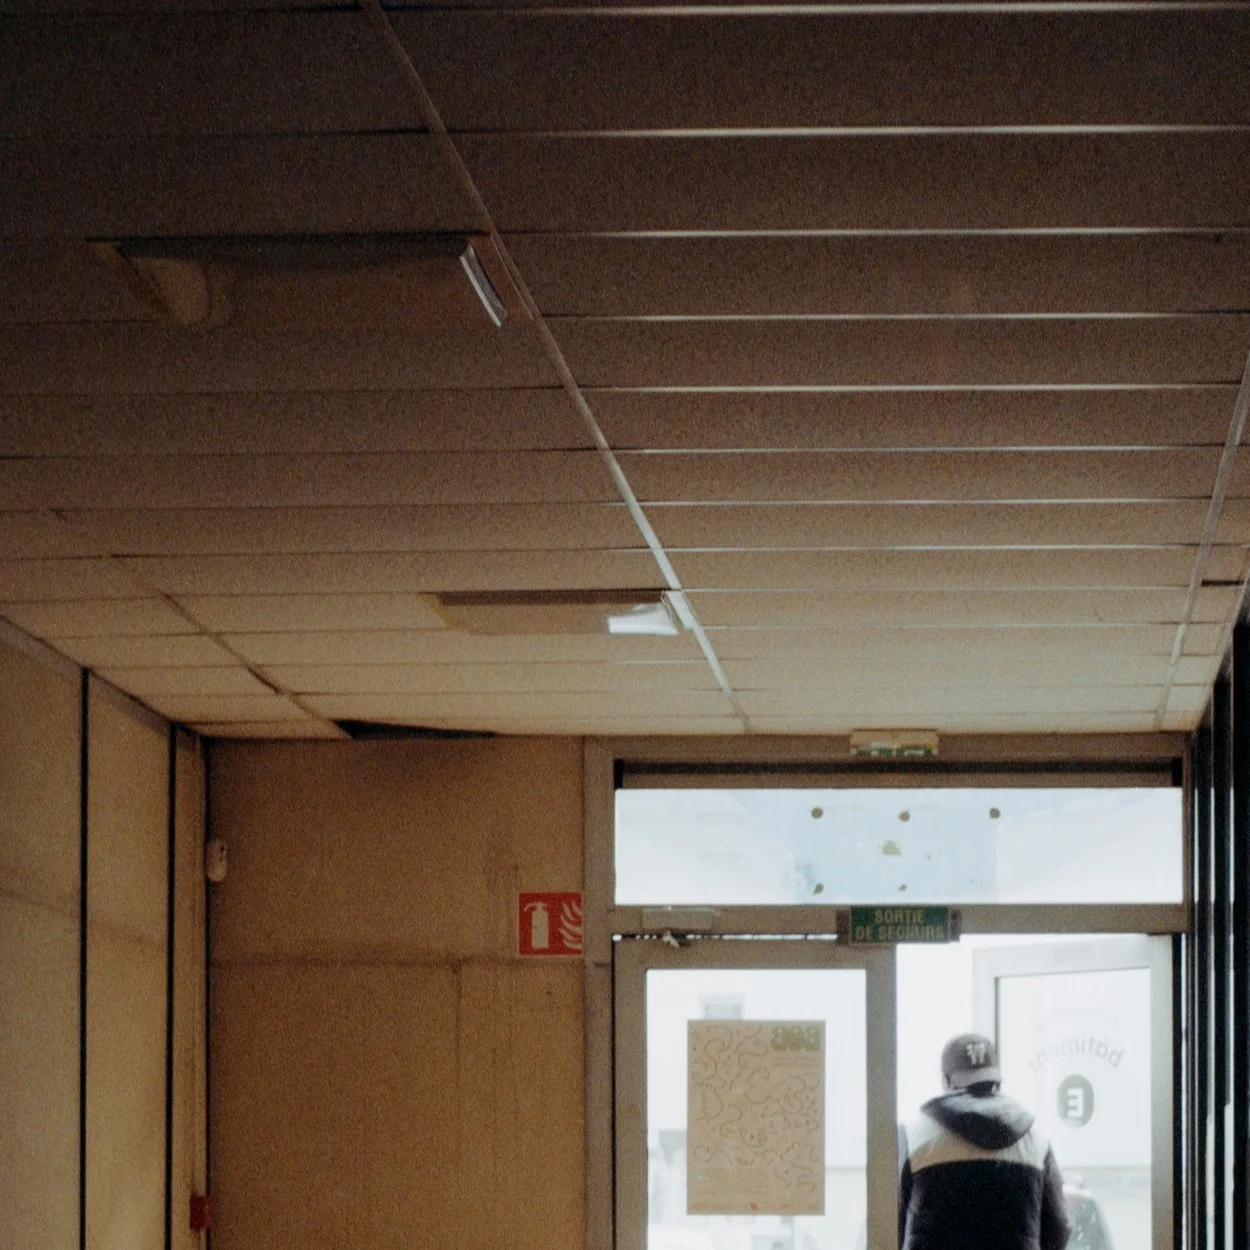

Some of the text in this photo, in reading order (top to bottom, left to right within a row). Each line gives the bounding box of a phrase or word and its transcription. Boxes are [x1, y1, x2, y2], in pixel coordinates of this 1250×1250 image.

[874, 908, 925, 924] SORTIE
[856, 925, 945, 941] DE SECOURS
